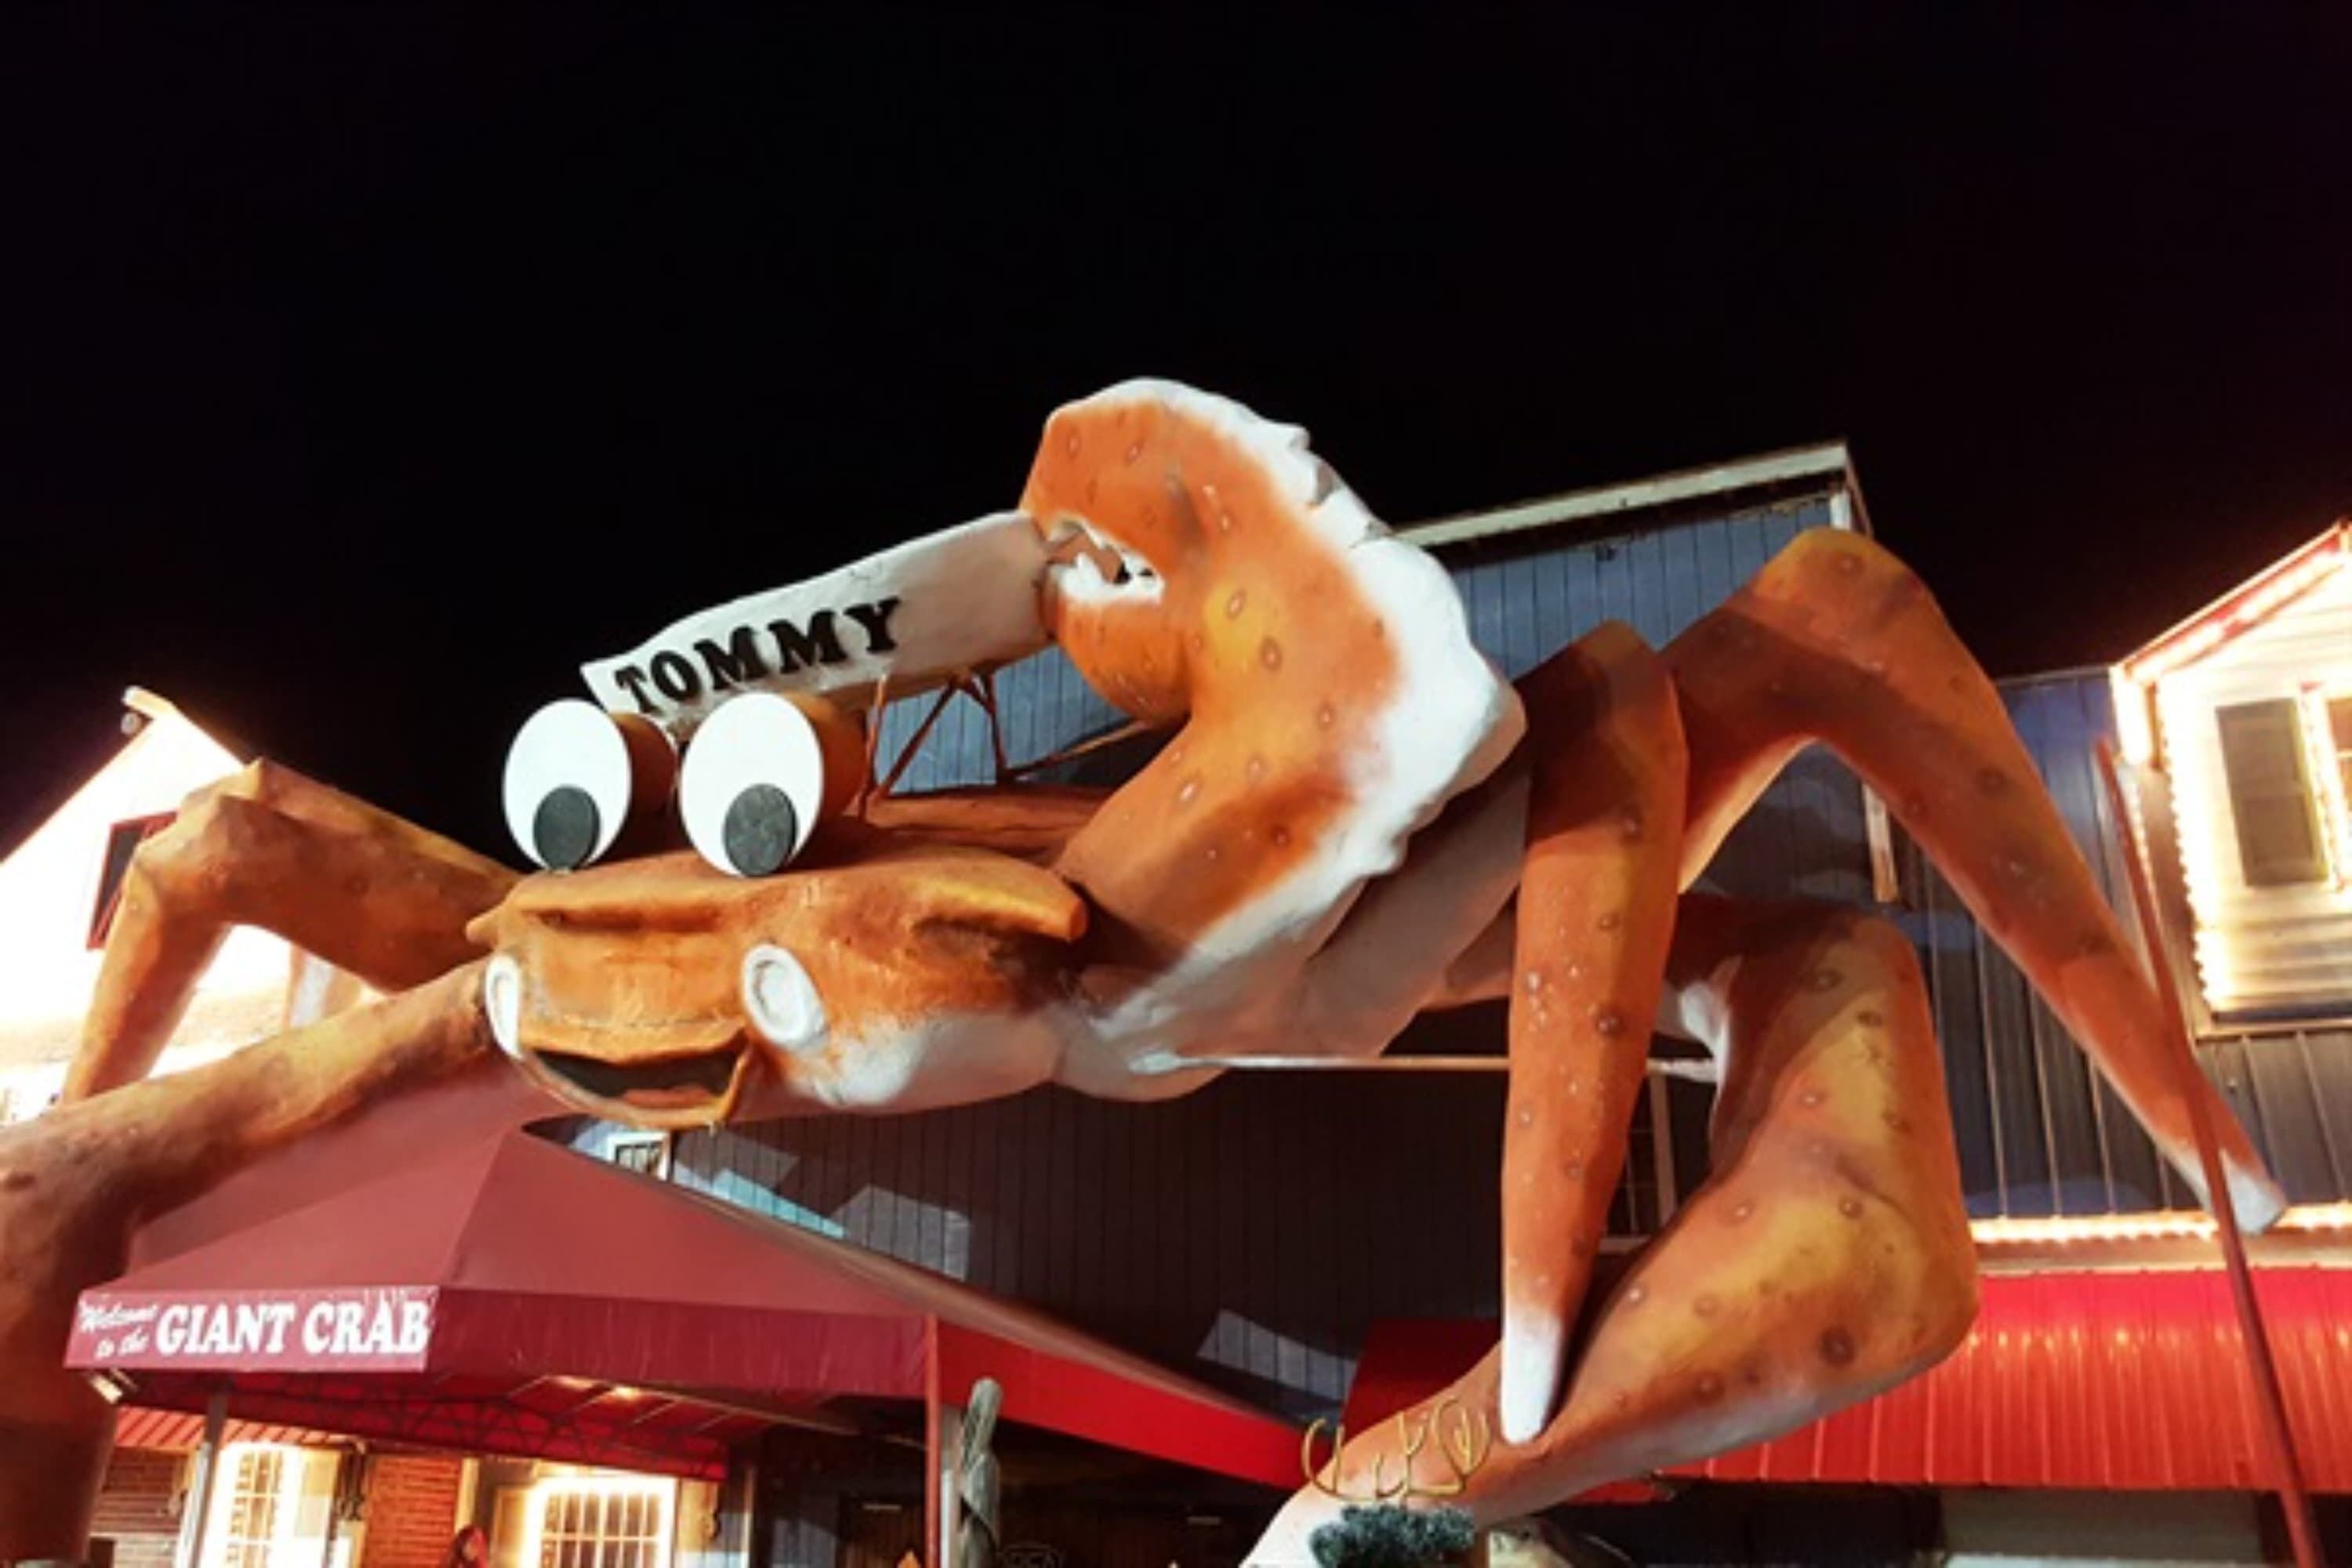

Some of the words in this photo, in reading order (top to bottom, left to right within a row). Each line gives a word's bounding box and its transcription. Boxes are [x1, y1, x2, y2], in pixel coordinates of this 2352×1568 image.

[615, 597, 902, 715] TOMMY
[94, 1338, 115, 1360] to
[118, 1325, 150, 1356] the
[156, 1303, 296, 1356] GIANT
[302, 1301, 431, 1356] CRAB
